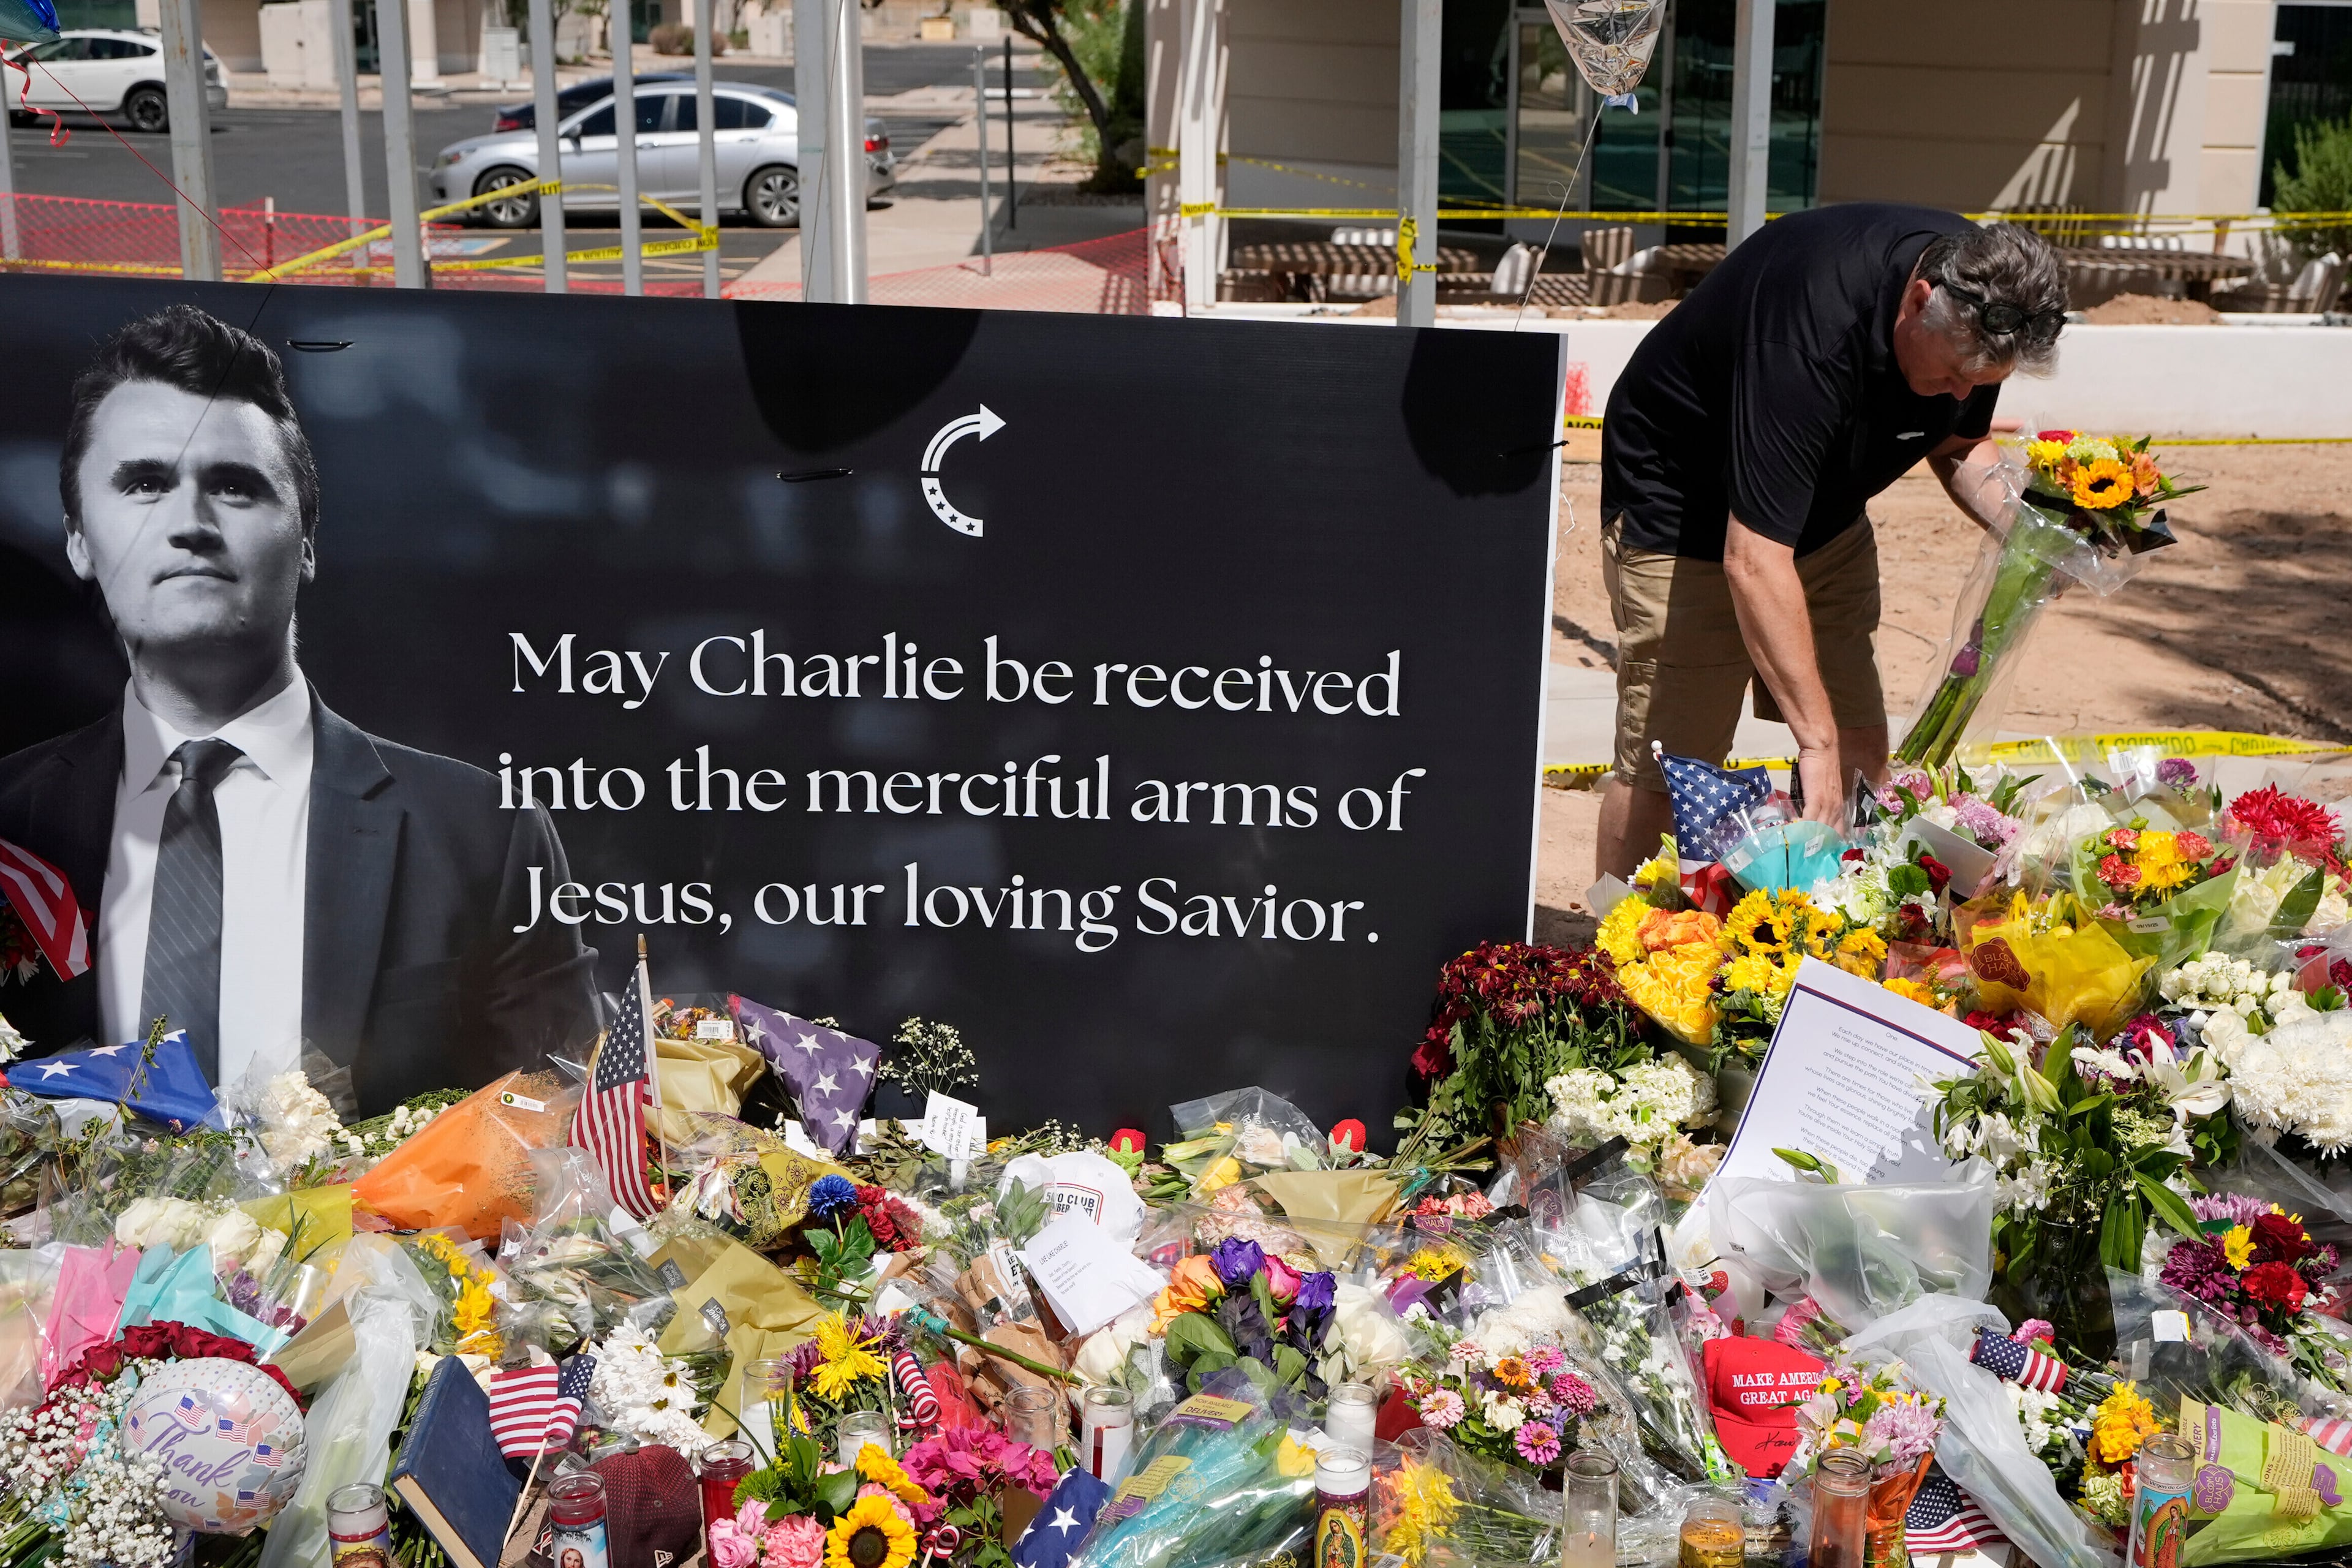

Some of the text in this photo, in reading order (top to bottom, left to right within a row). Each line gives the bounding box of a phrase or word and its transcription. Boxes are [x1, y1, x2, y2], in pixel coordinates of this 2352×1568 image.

[509, 629, 1400, 715] May Charlie be received
[499, 745, 1426, 831] into the merciful arms of
[513, 862, 1378, 952] Jesus, our loving Savior.
[1834, 1047, 1843, 1055] We
[1843, 1053, 1856, 1061] step
[1856, 1058, 1868, 1067] into
[1868, 1063, 1877, 1072] the
[1877, 1069, 1889, 1077] role
[1838, 1026, 1853, 1036] Each
[1852, 1033, 1864, 1042] day
[1874, 1042, 1888, 1053] have
[1898, 1055, 1914, 1065] place
[1834, 1057, 1854, 1068] pursue
[1879, 1076, 1889, 1086] You
[1888, 1081, 1902, 1093] have
[1885, 1057, 1898, 1065] and
[1896, 1062, 1913, 1072] share
[1804, 1066, 1823, 1077] whose
[1823, 1073, 1836, 1084] lives
[1868, 1097, 1887, 1111] shining
[1887, 1106, 1907, 1121] brightly
[1816, 1085, 1832, 1098] When
[1832, 1094, 1847, 1106] these
[1846, 1102, 1866, 1115] people
[1866, 1113, 1879, 1123] walk
[1825, 1066, 1841, 1078] There
[1852, 1080, 1867, 1091] times
[1875, 1092, 1891, 1104] those
[1891, 1101, 1904, 1110] who
[1804, 1103, 1826, 1119] Through
[1826, 1115, 1841, 1127] them
[1850, 1128, 1864, 1139] learn
[1868, 1139, 1887, 1153] simple
[1816, 1094, 1828, 1103] feel
[1828, 1099, 1840, 1109] Your
[1863, 1119, 1883, 1133] replace
[1800, 1126, 1815, 1139] When
[1815, 1135, 1830, 1147] these
[1830, 1144, 1849, 1157] people
[1859, 1159, 1869, 1167] too
[1803, 1136, 1815, 1146] their
[1814, 1143, 1833, 1157] legacy
[1837, 1156, 1858, 1170] second
[1813, 1118, 1826, 1128] alive
[1842, 1132, 1855, 1142] Your
[1853, 1139, 1866, 1150] Holy
[1866, 1145, 1882, 1157] Spirit
[1067, 1194, 1095, 1208] CLUB
[1732, 1372, 1822, 1387] MAKE AMERIC
[1740, 1391, 1787, 1405] GREAT
[1185, 1404, 1225, 1420] DELIVERY
[1207, 1399, 1234, 1409] AVAILABLE
[146, 1411, 251, 1487] Thank
[2192, 1421, 2203, 1457] LIVERY
[2149, 1479, 2167, 1490] Virgen
[2213, 1476, 2224, 1505] HAUS
